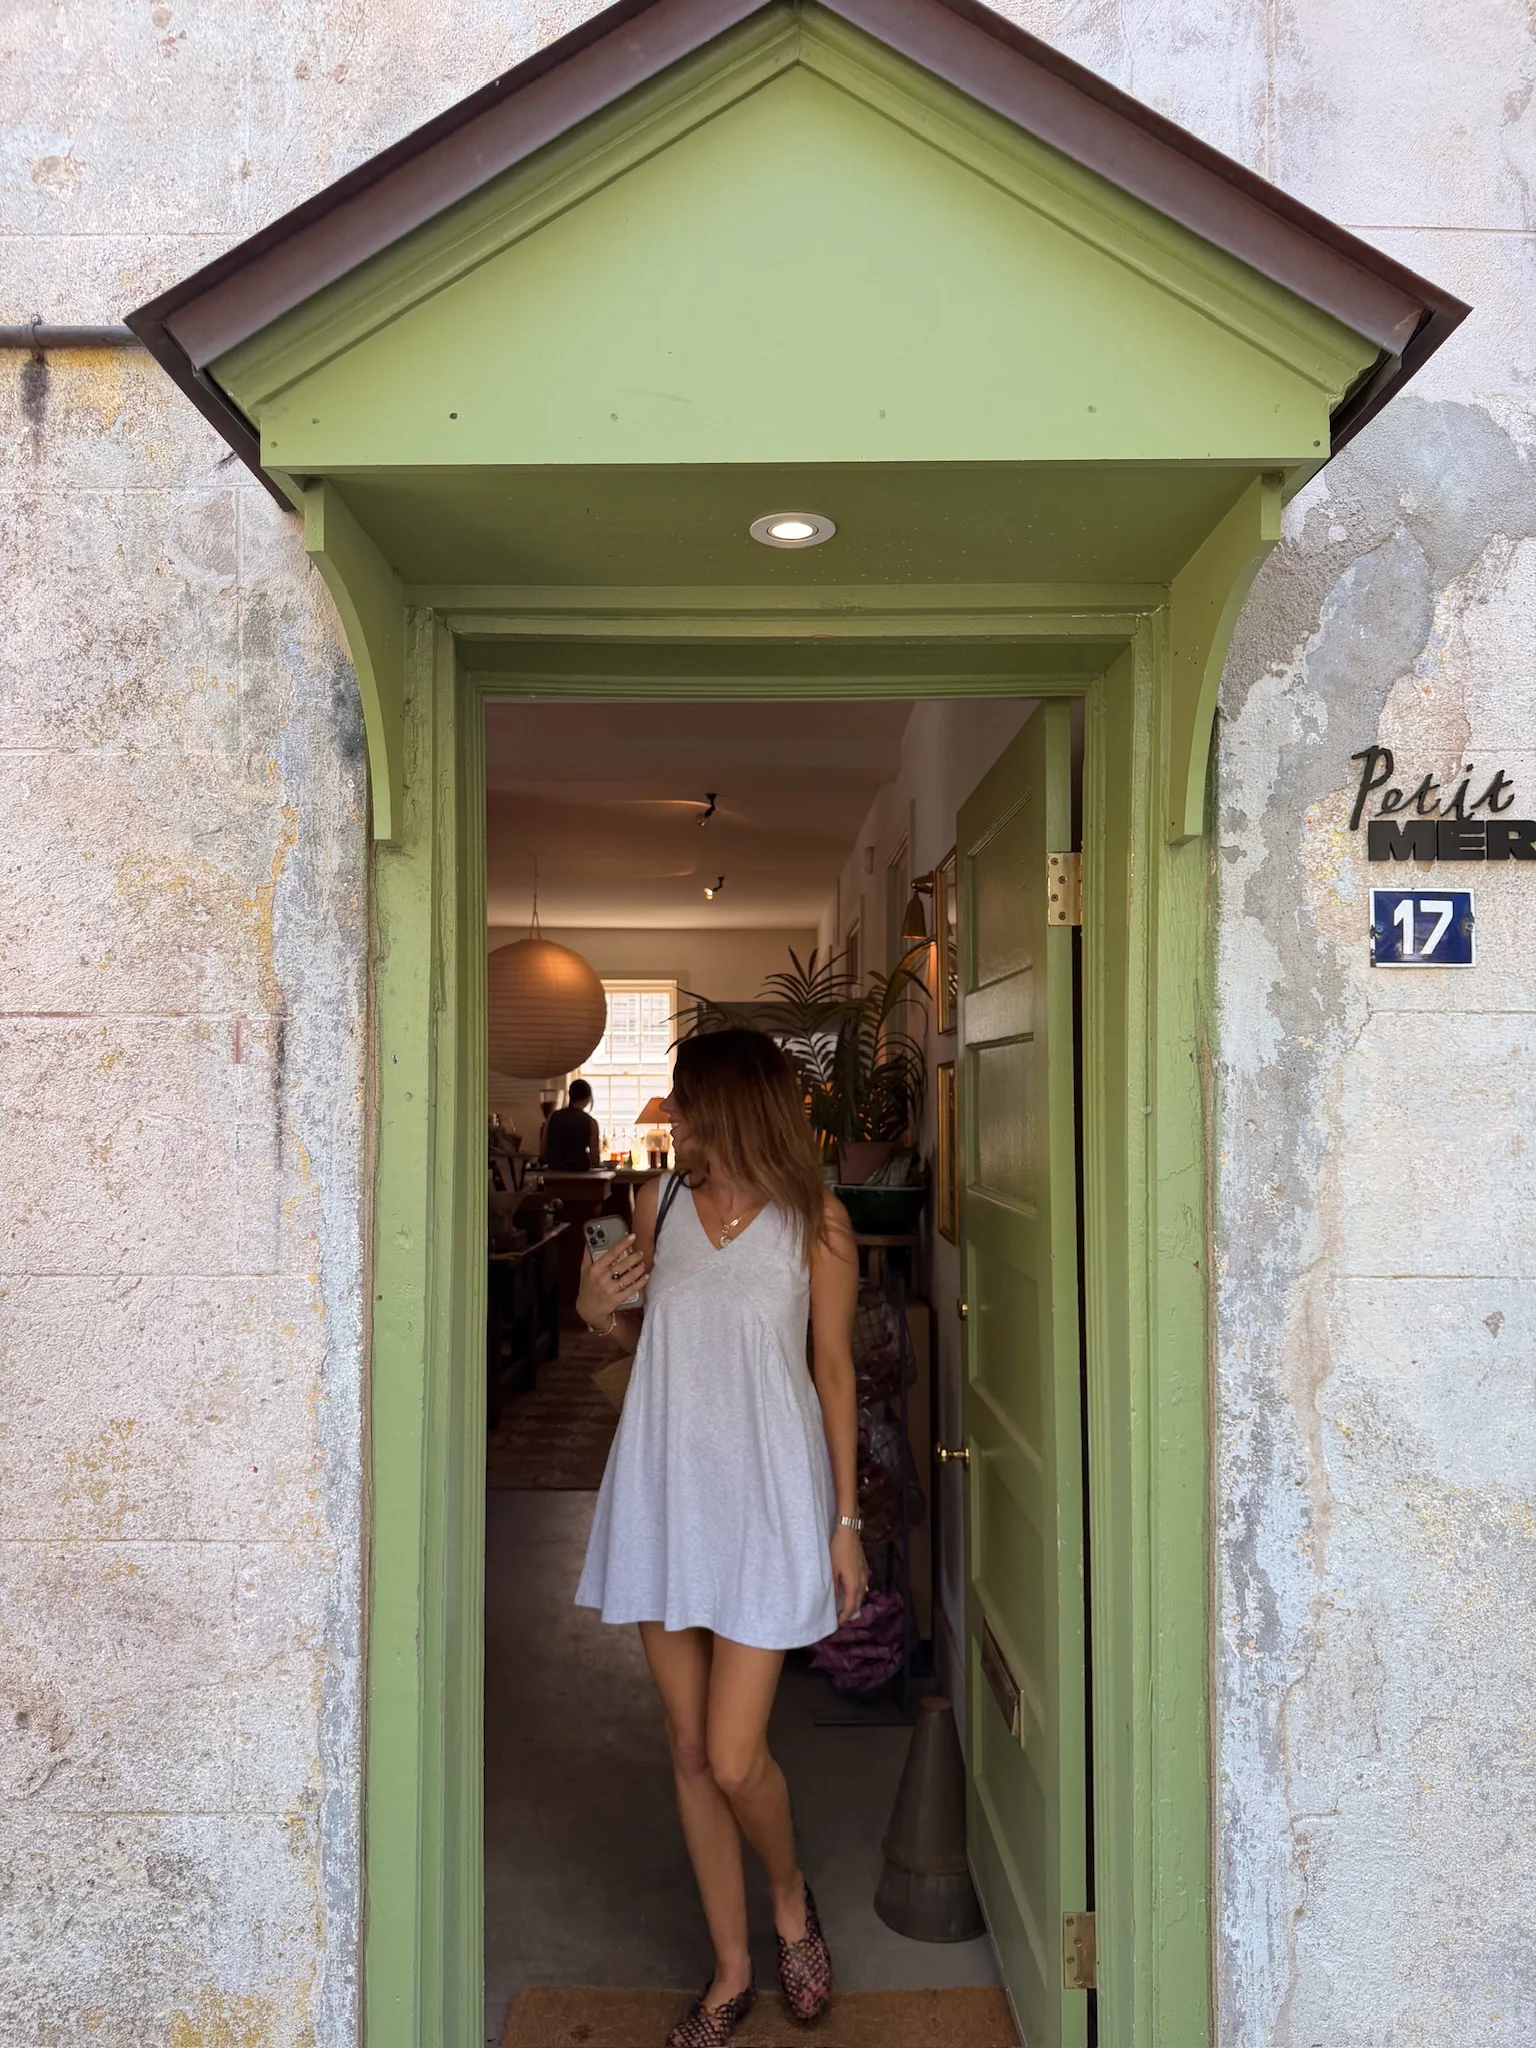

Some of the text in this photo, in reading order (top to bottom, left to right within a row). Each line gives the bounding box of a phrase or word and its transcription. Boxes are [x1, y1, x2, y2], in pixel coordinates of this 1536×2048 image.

[1350, 745, 1515, 831] Petit
[1368, 820, 1536, 861] MER
[1393, 899, 1454, 955] 17
